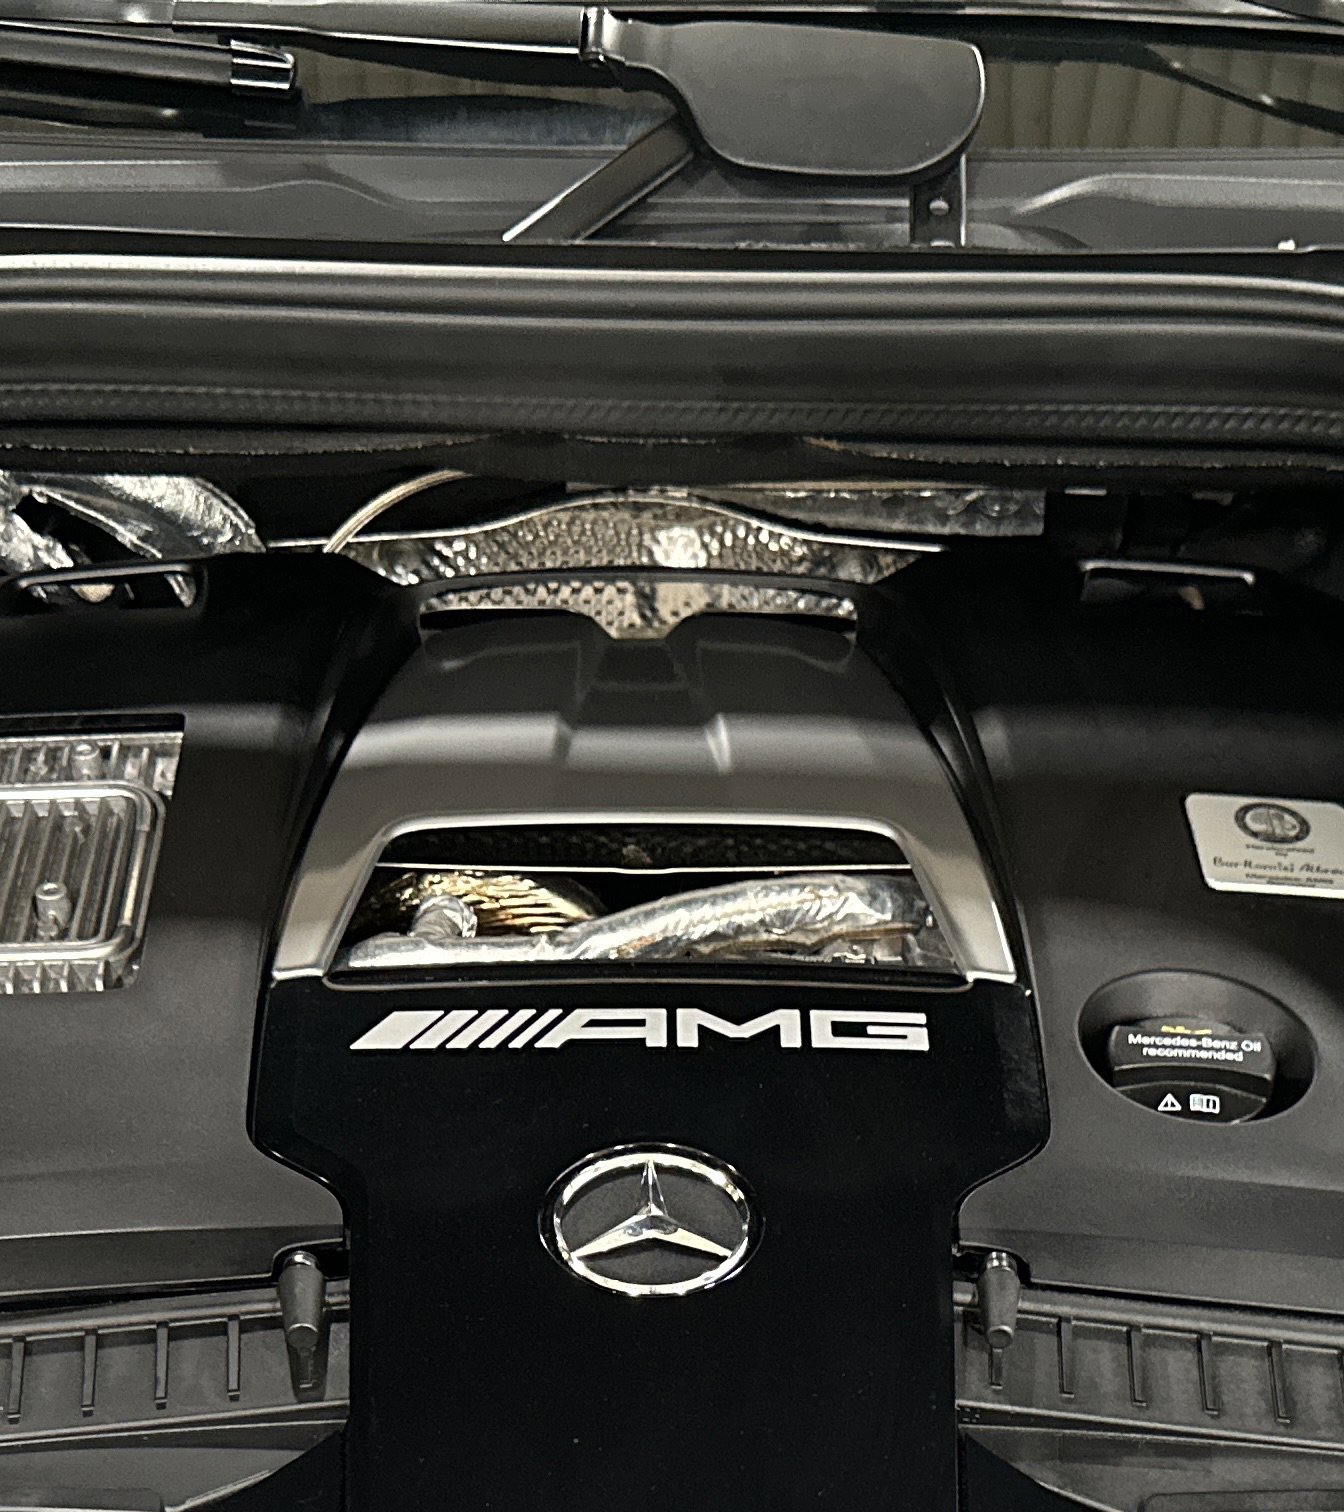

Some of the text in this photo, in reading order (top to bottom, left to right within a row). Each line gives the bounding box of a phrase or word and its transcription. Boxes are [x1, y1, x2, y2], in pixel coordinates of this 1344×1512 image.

[534, 1007, 930, 1051] AMG
[1127, 1033, 1262, 1052] Mercedes-Benz Oil
[1142, 1047, 1244, 1062] recommended
